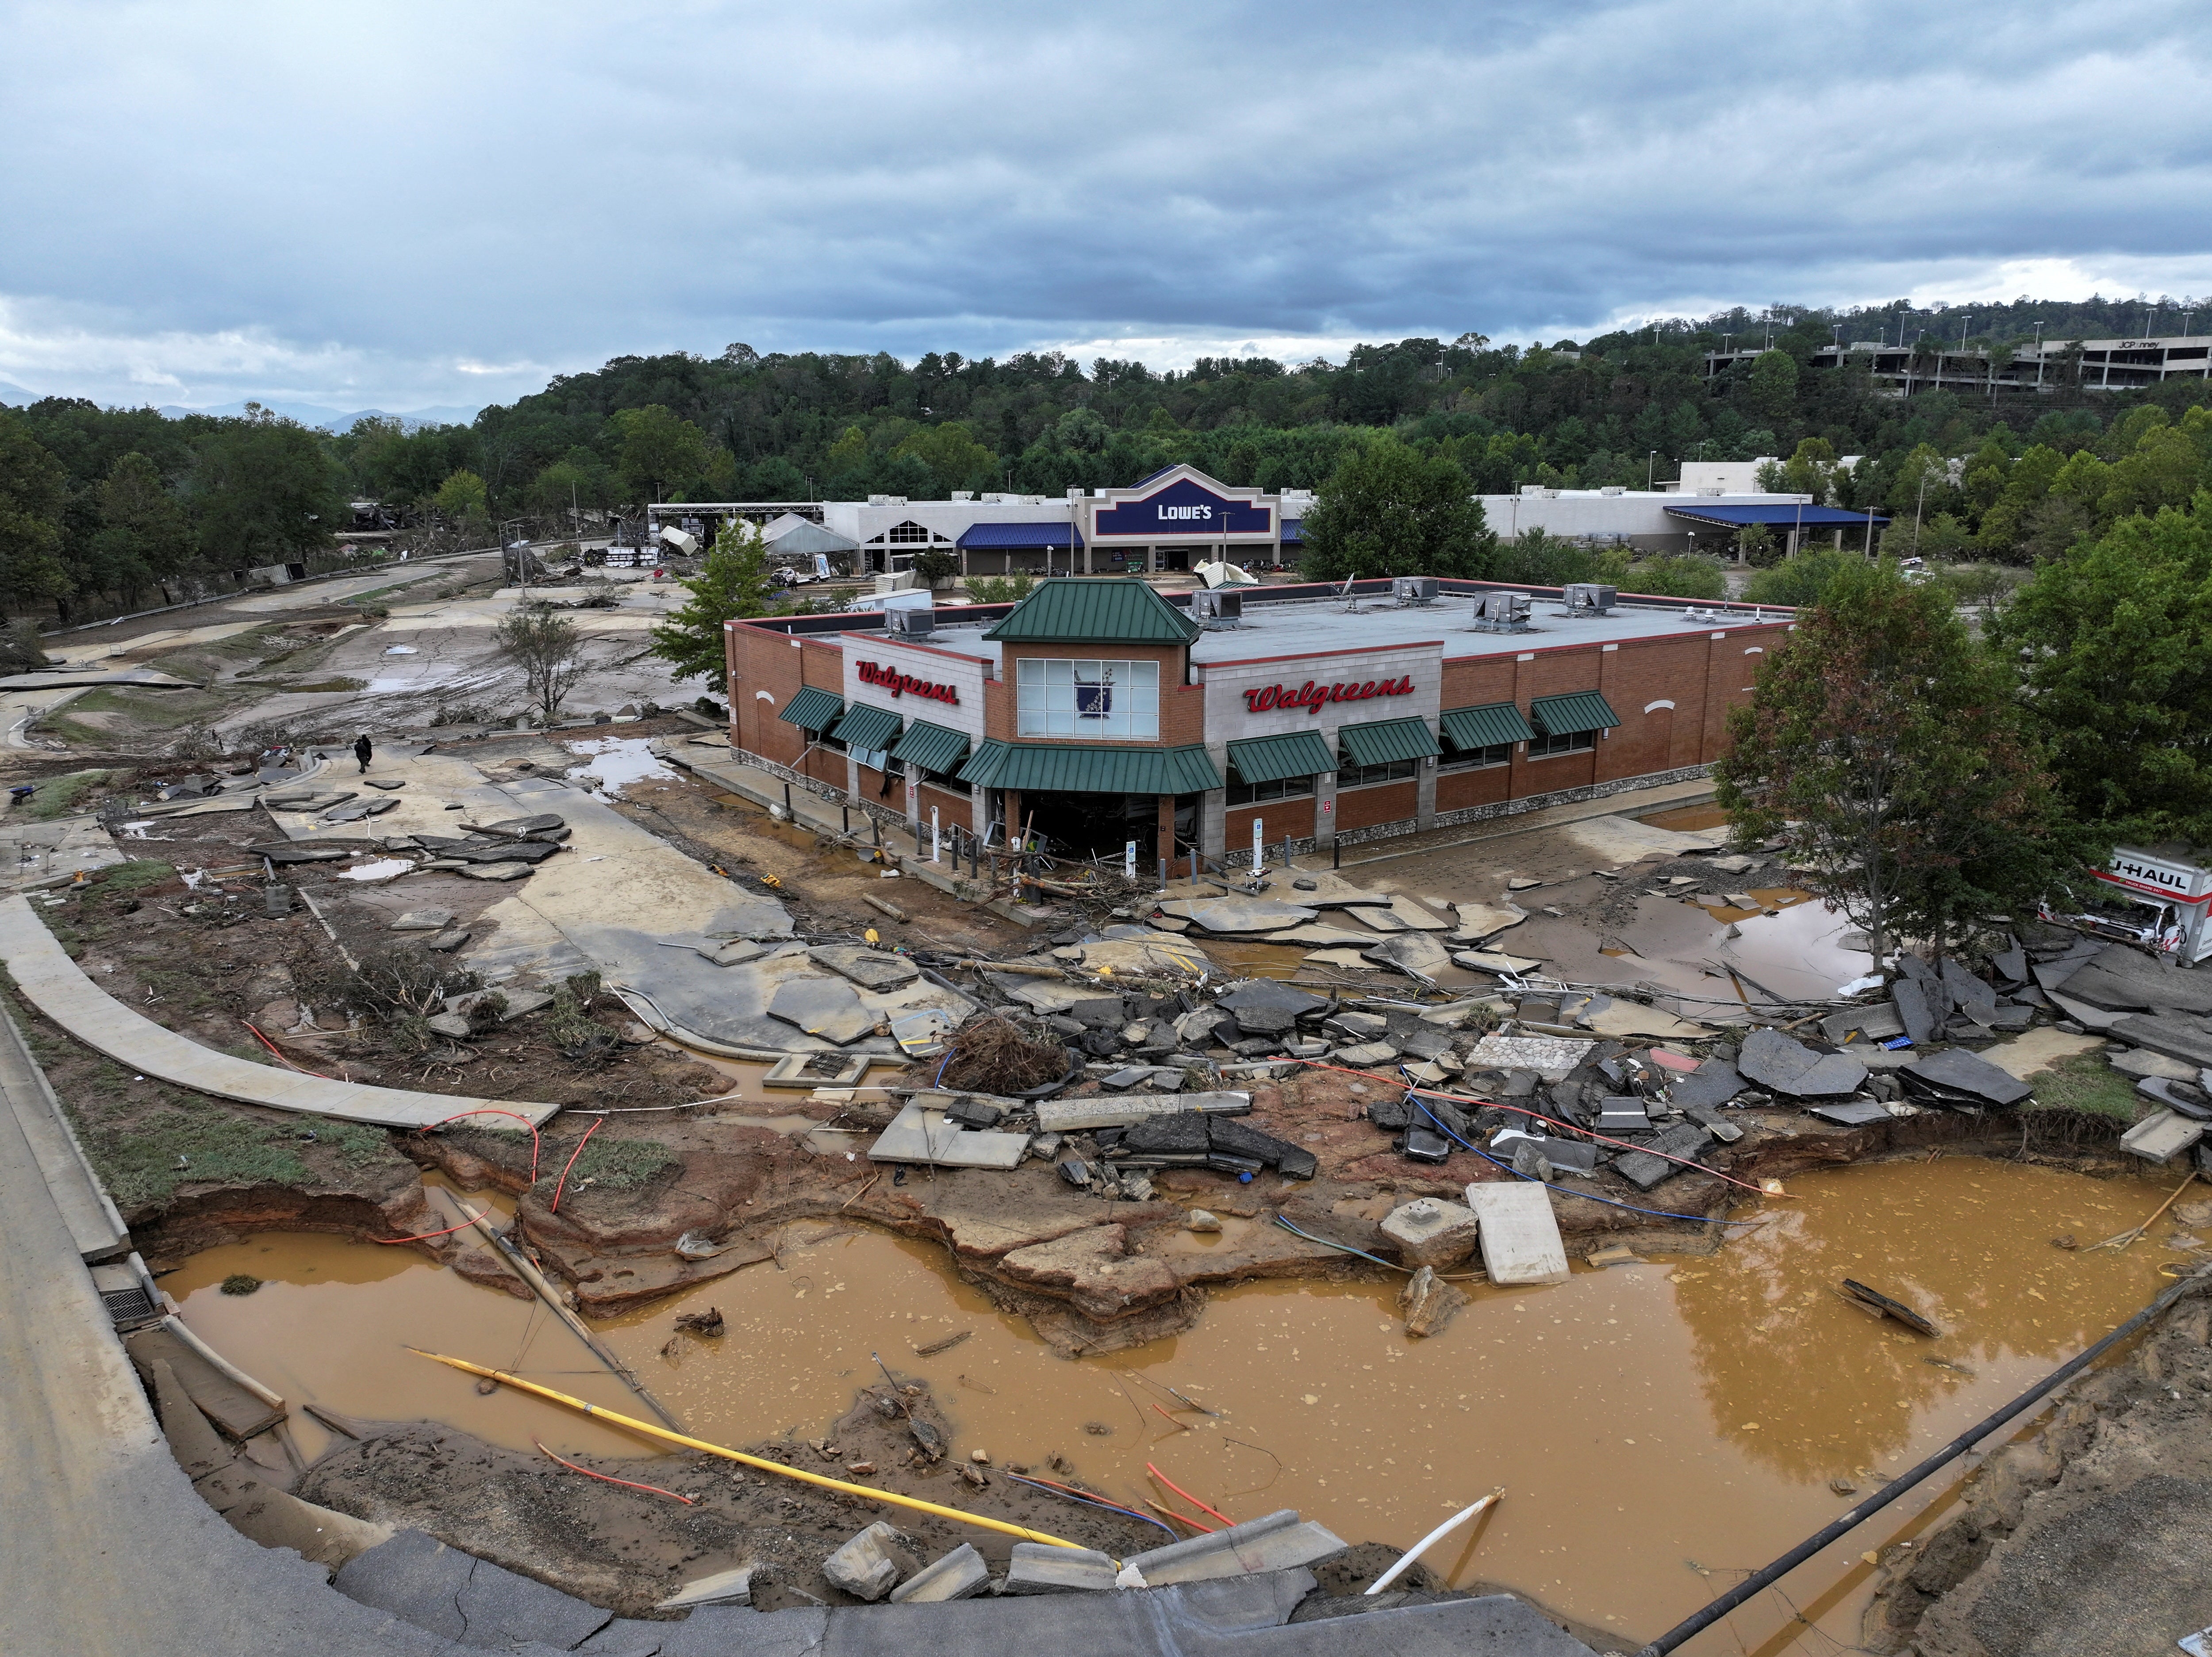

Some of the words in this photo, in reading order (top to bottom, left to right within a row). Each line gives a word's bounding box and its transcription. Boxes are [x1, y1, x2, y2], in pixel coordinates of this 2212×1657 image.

[1158, 504, 1212, 520] LOWE'S
[856, 660, 959, 705] Walgreens
[1244, 675, 1415, 714] Walgreens
